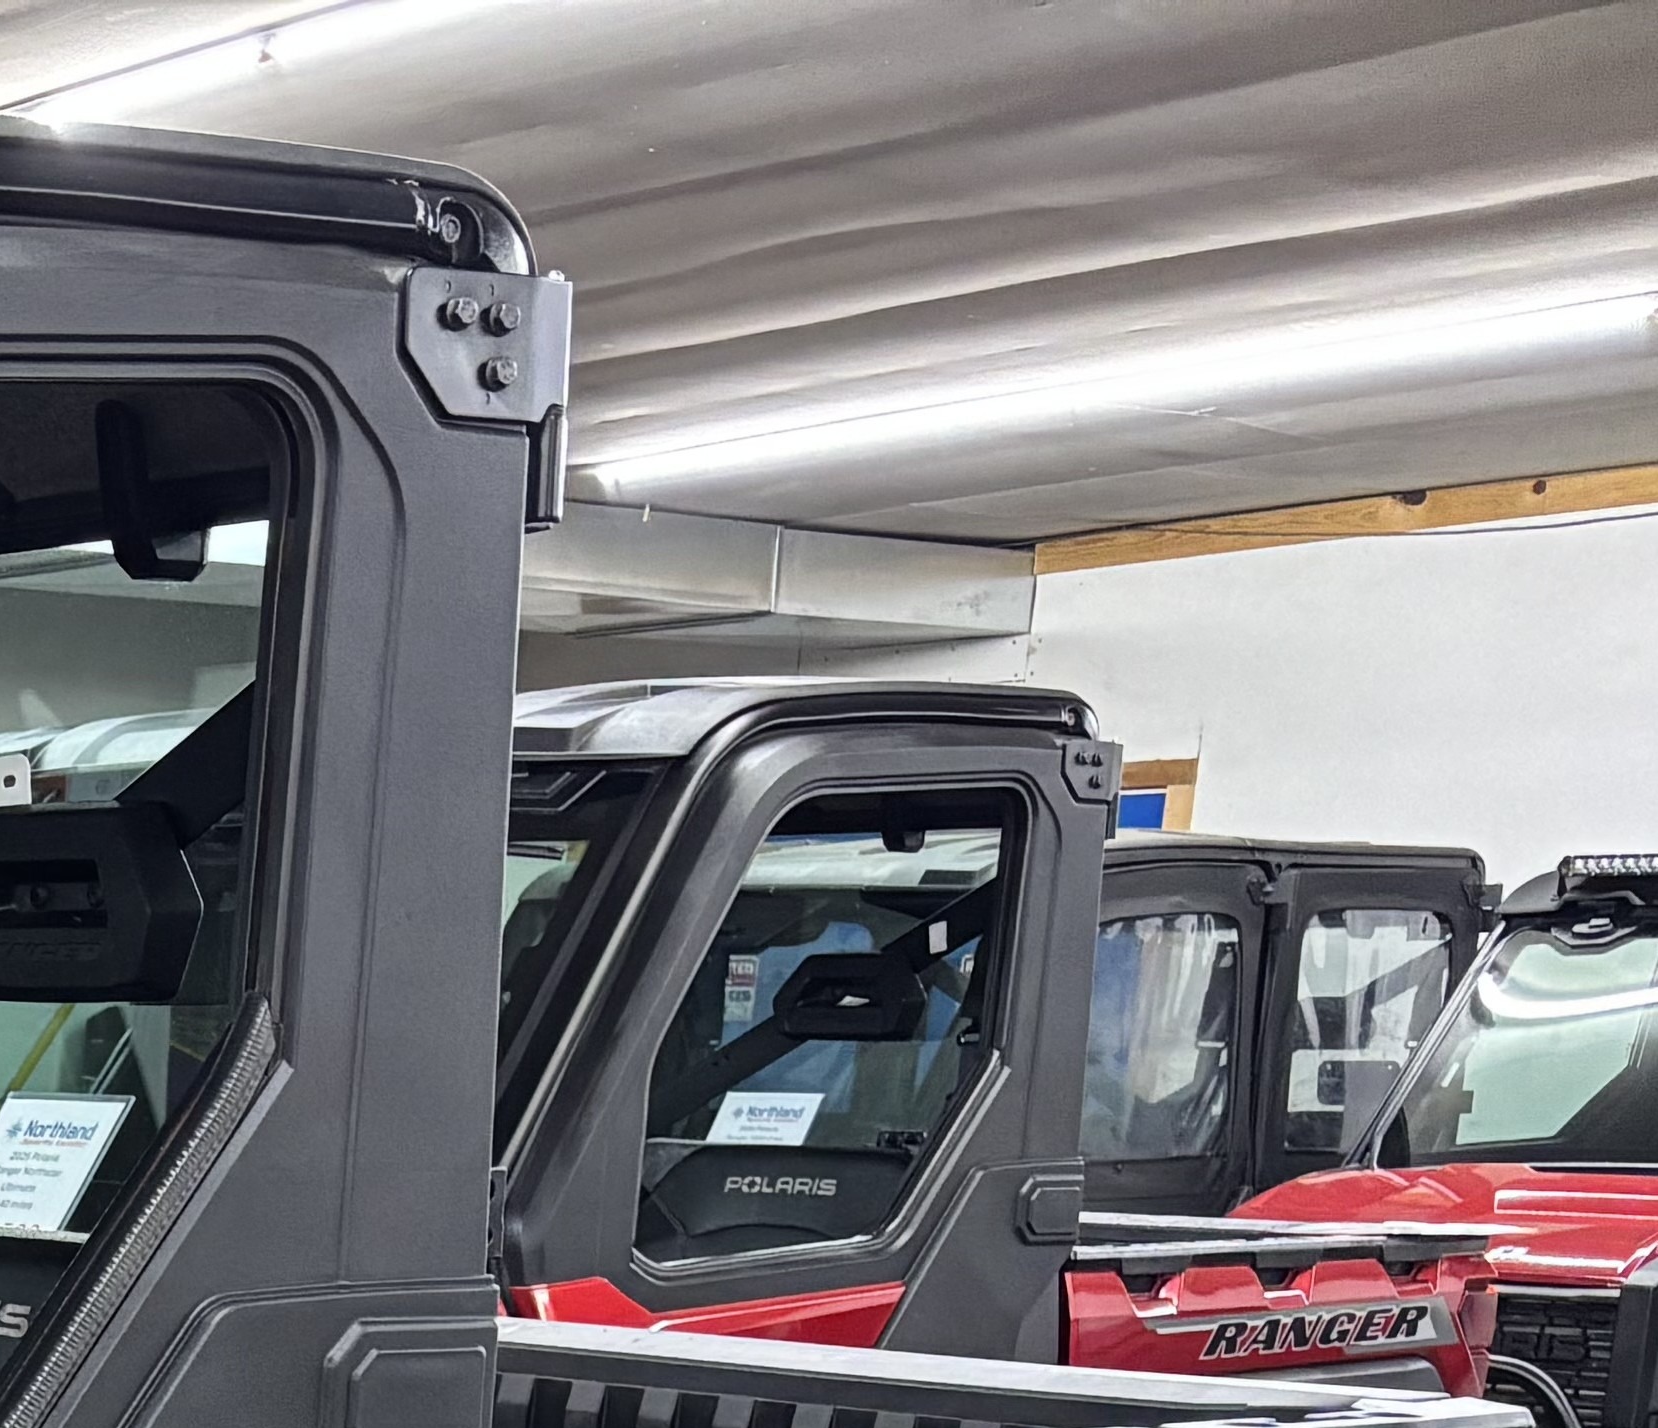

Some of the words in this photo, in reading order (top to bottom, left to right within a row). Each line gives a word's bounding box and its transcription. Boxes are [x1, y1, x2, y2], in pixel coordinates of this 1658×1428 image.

[23, 1119, 99, 1141] Northland
[724, 1175, 837, 1196] POLARIS
[1199, 1303, 1429, 1360] RANGER
